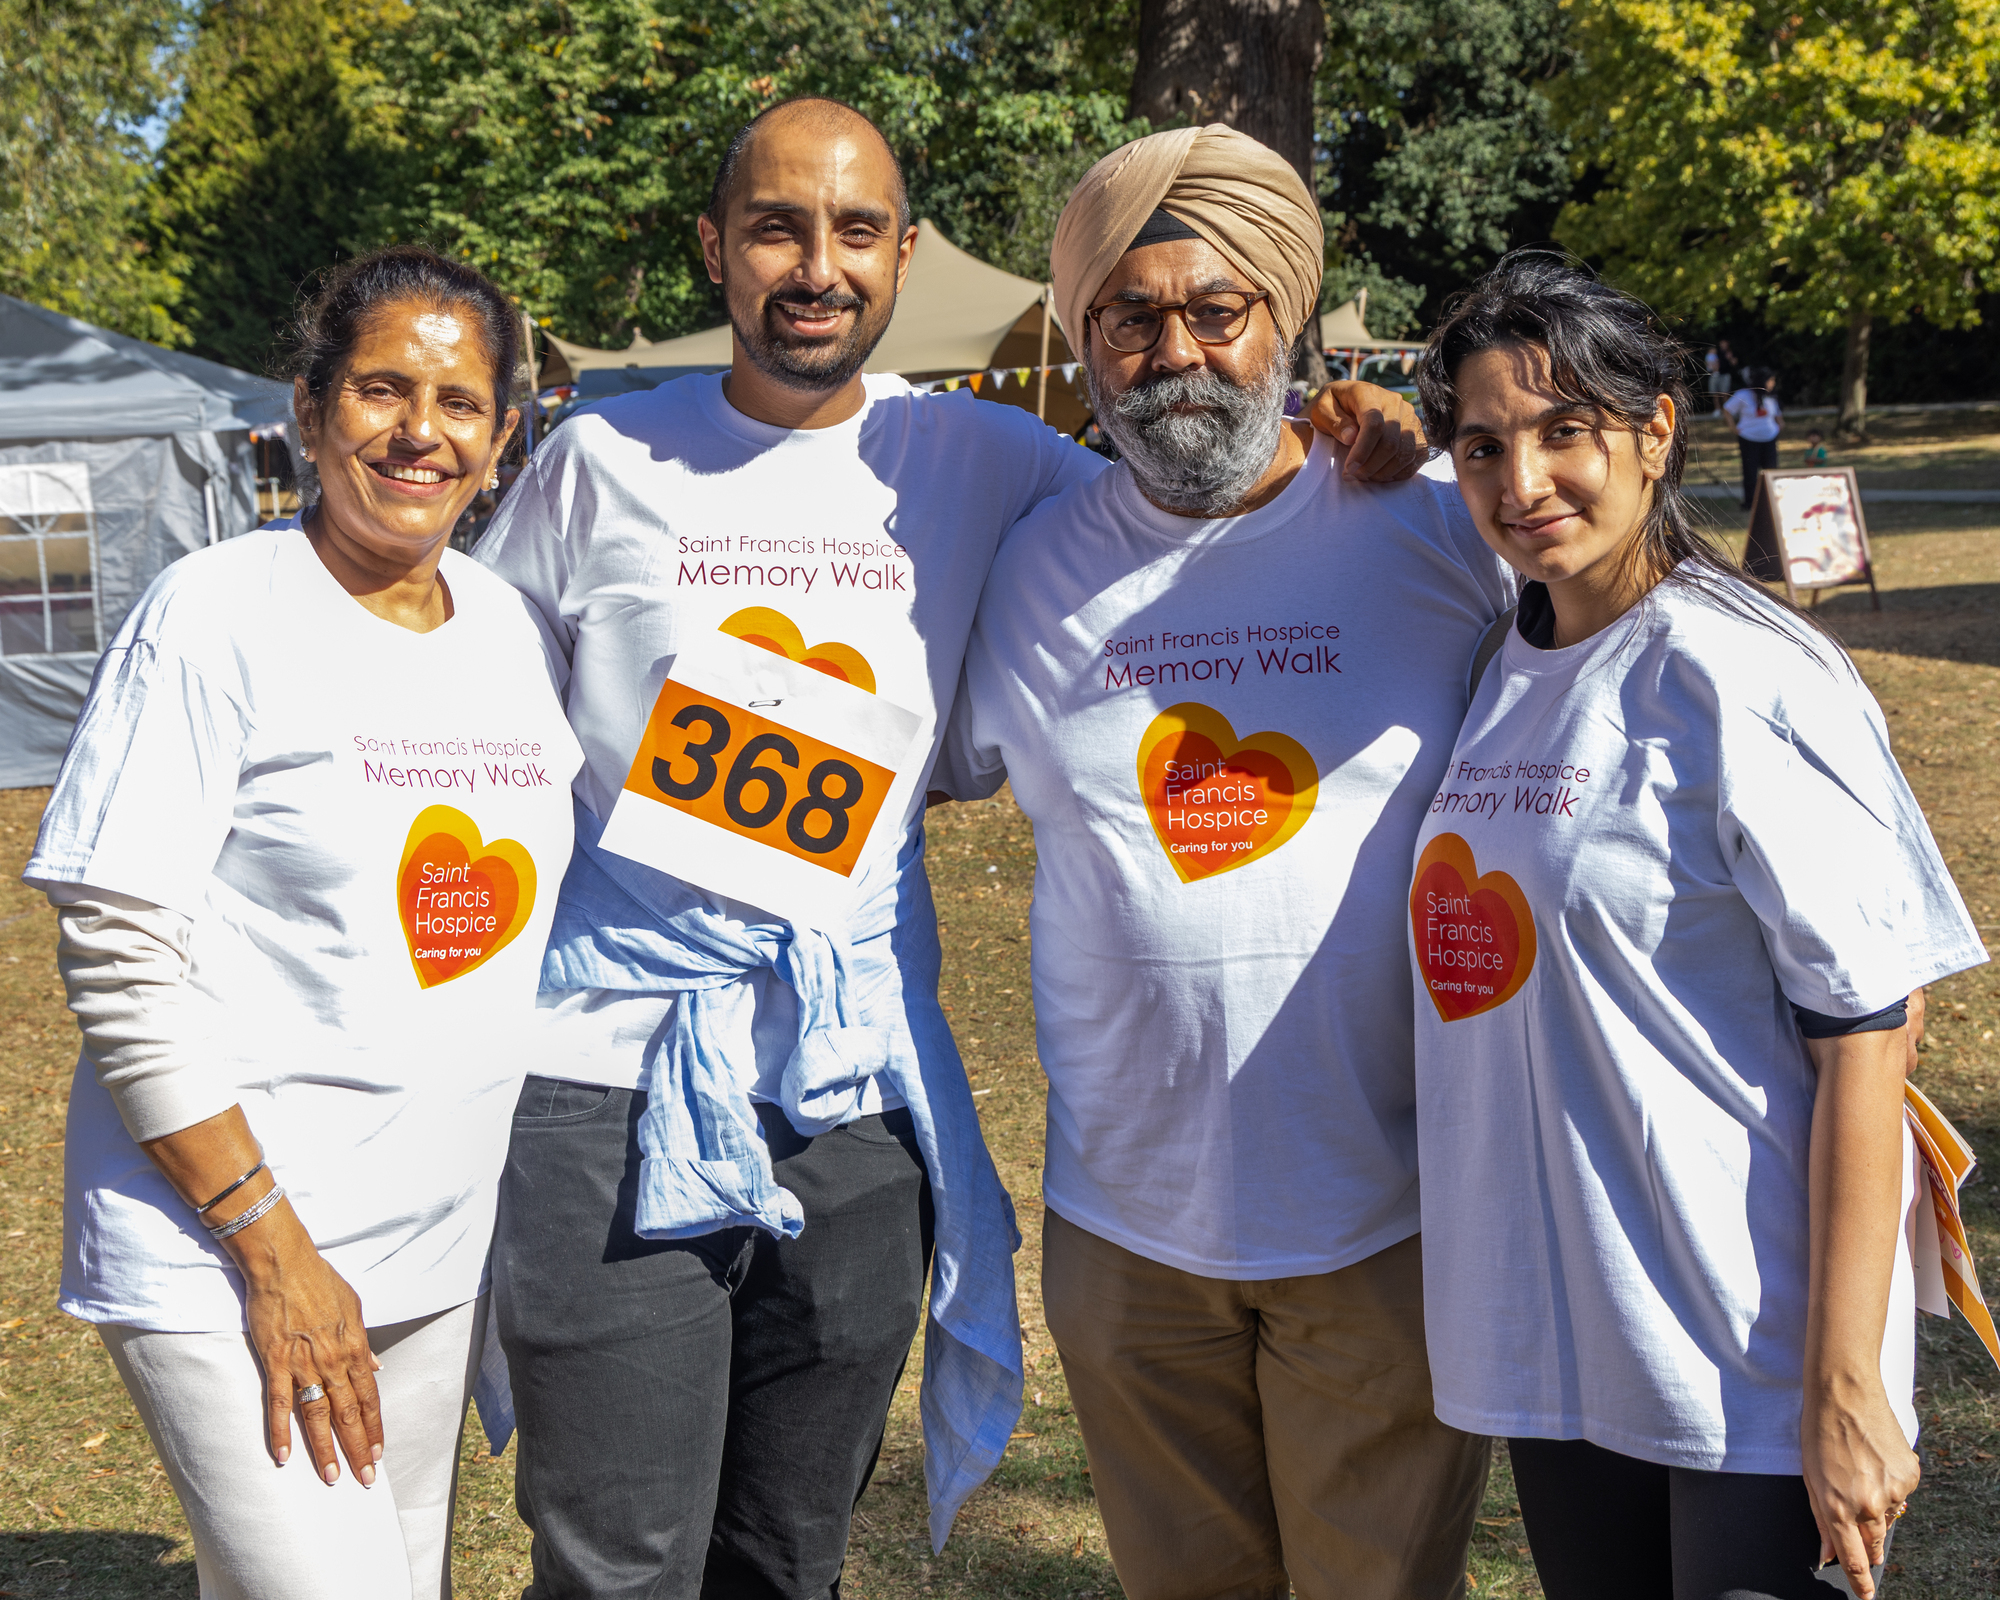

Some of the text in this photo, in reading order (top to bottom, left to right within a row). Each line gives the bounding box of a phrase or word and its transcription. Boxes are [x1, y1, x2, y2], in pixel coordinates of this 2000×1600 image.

[678, 535, 907, 560] Saint Francis Hospice
[677, 560, 906, 594] Memory Walk
[1104, 621, 1340, 658] Saint Francis Hospice
[1105, 646, 1343, 690] Memory Walk
[401, 737, 468, 756] Francis
[472, 738, 542, 760] Hospice
[363, 759, 553, 793] Memory Walk
[651, 704, 864, 854] 368
[1164, 758, 1227, 781] Saint
[1457, 760, 1513, 782] Francis
[1514, 759, 1590, 783] Hospice
[1166, 780, 1256, 806] Francis
[1429, 786, 1580, 820] emory Walk
[1168, 805, 1268, 832] Hospice
[1170, 840, 1253, 854] Caring for you
[420, 862, 471, 884] Saint
[416, 886, 490, 909] Francis
[1426, 891, 1472, 916] Saint
[415, 911, 497, 938] Hospice
[1427, 917, 1493, 943] Francis
[414, 946, 482, 960] Caring for you
[1428, 943, 1503, 972] Hospice
[1430, 979, 1494, 995] Caring for you
